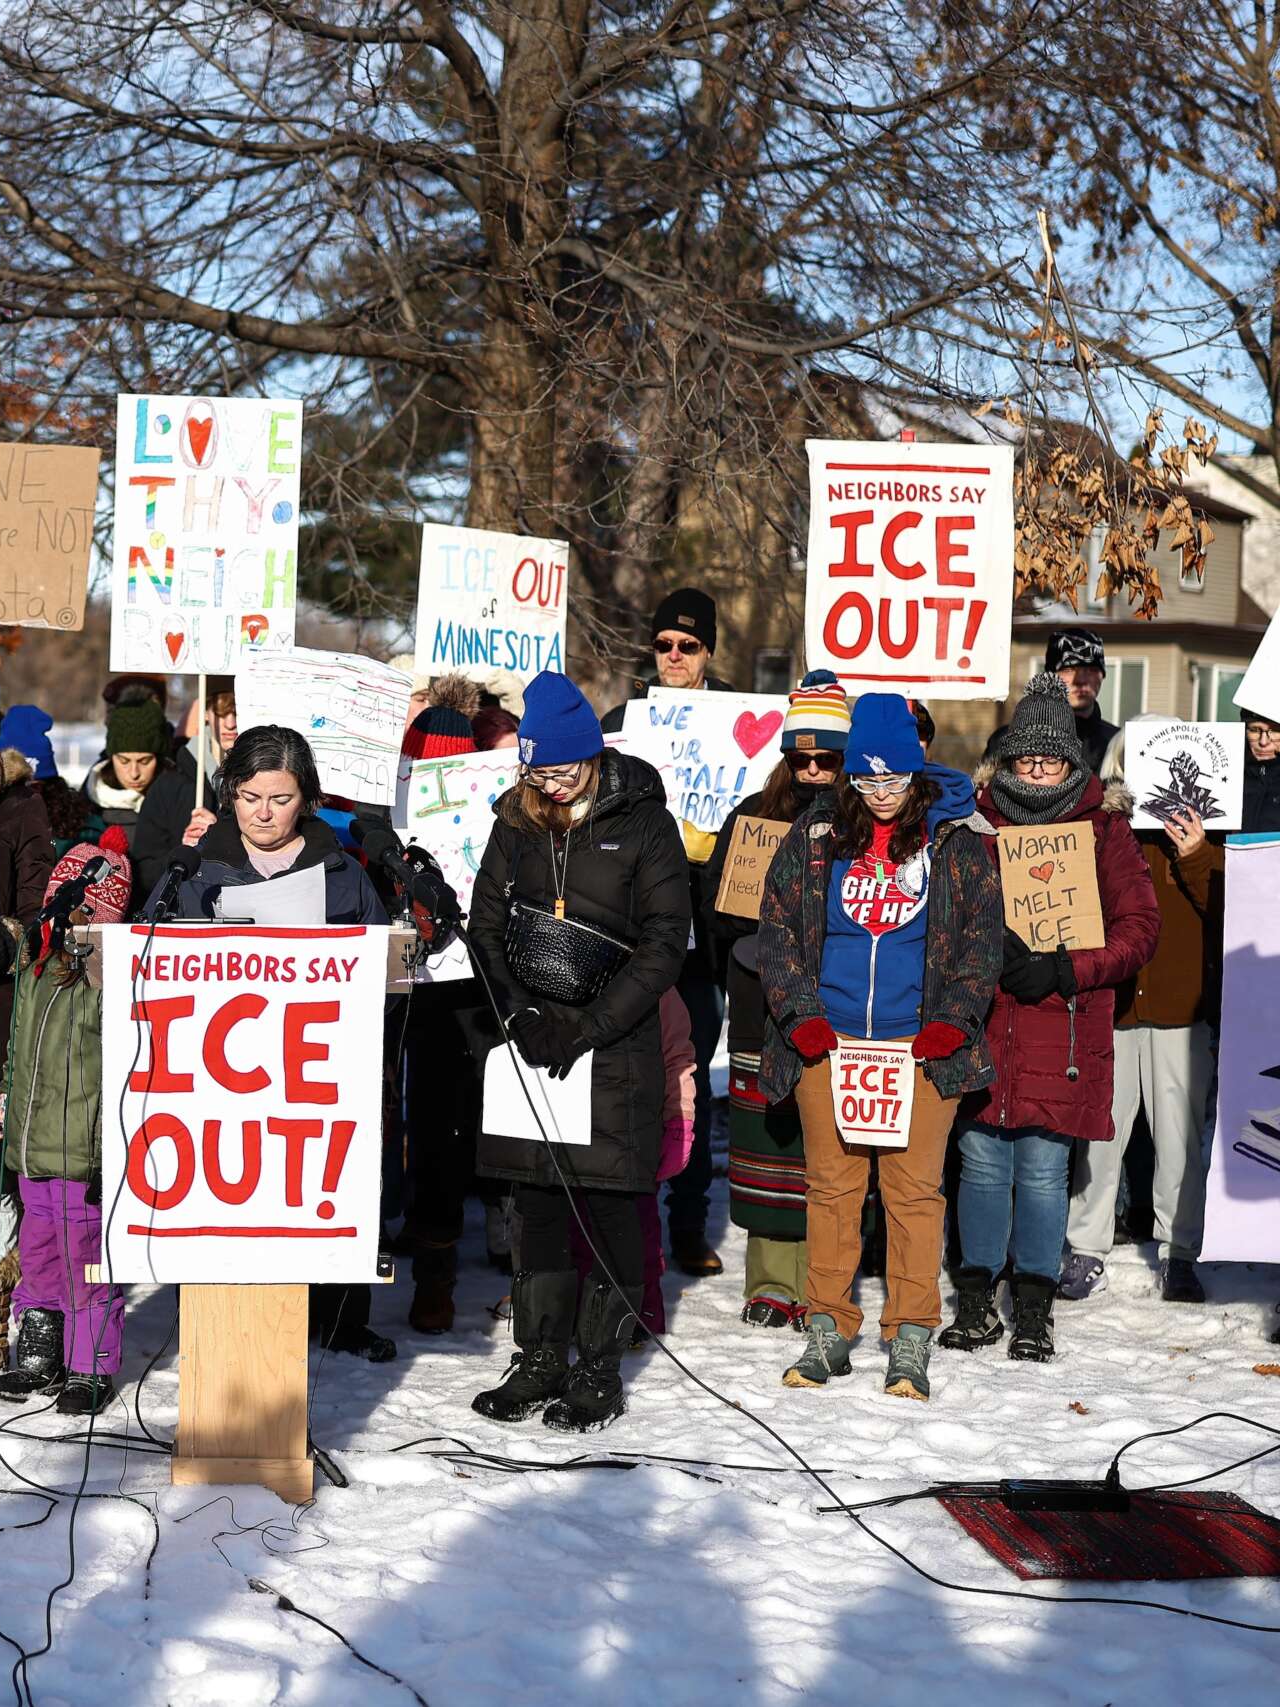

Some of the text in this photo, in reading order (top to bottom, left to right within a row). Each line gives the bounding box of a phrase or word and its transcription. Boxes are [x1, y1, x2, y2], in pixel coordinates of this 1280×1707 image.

[133, 398, 297, 474] LOVE
[128, 475, 282, 535] THY
[827, 481, 987, 504] NEIGHBORS SAY
[35, 507, 96, 553] NOT
[828, 510, 976, 588] ICE
[437, 543, 566, 608] ICE OUT
[481, 598, 498, 619] of
[431, 616, 563, 673] MINNESOTA
[822, 591, 988, 669] OUT!
[648, 705, 694, 731] WE
[1146, 725, 1199, 748] MINNEAPOLIS
[741, 821, 784, 849] Min
[733, 853, 757, 869] are
[727, 879, 761, 897] need
[1013, 887, 1078, 919] MELT
[1028, 915, 1076, 947] ICE
[130, 951, 360, 983] NEIGHBORS SAY
[128, 992, 341, 1105] ICE
[839, 1052, 906, 1065] NEIGHBORS SAY
[839, 1063, 901, 1096] ICE
[841, 1095, 903, 1128] OUT!
[125, 1112, 358, 1220] OUT!
